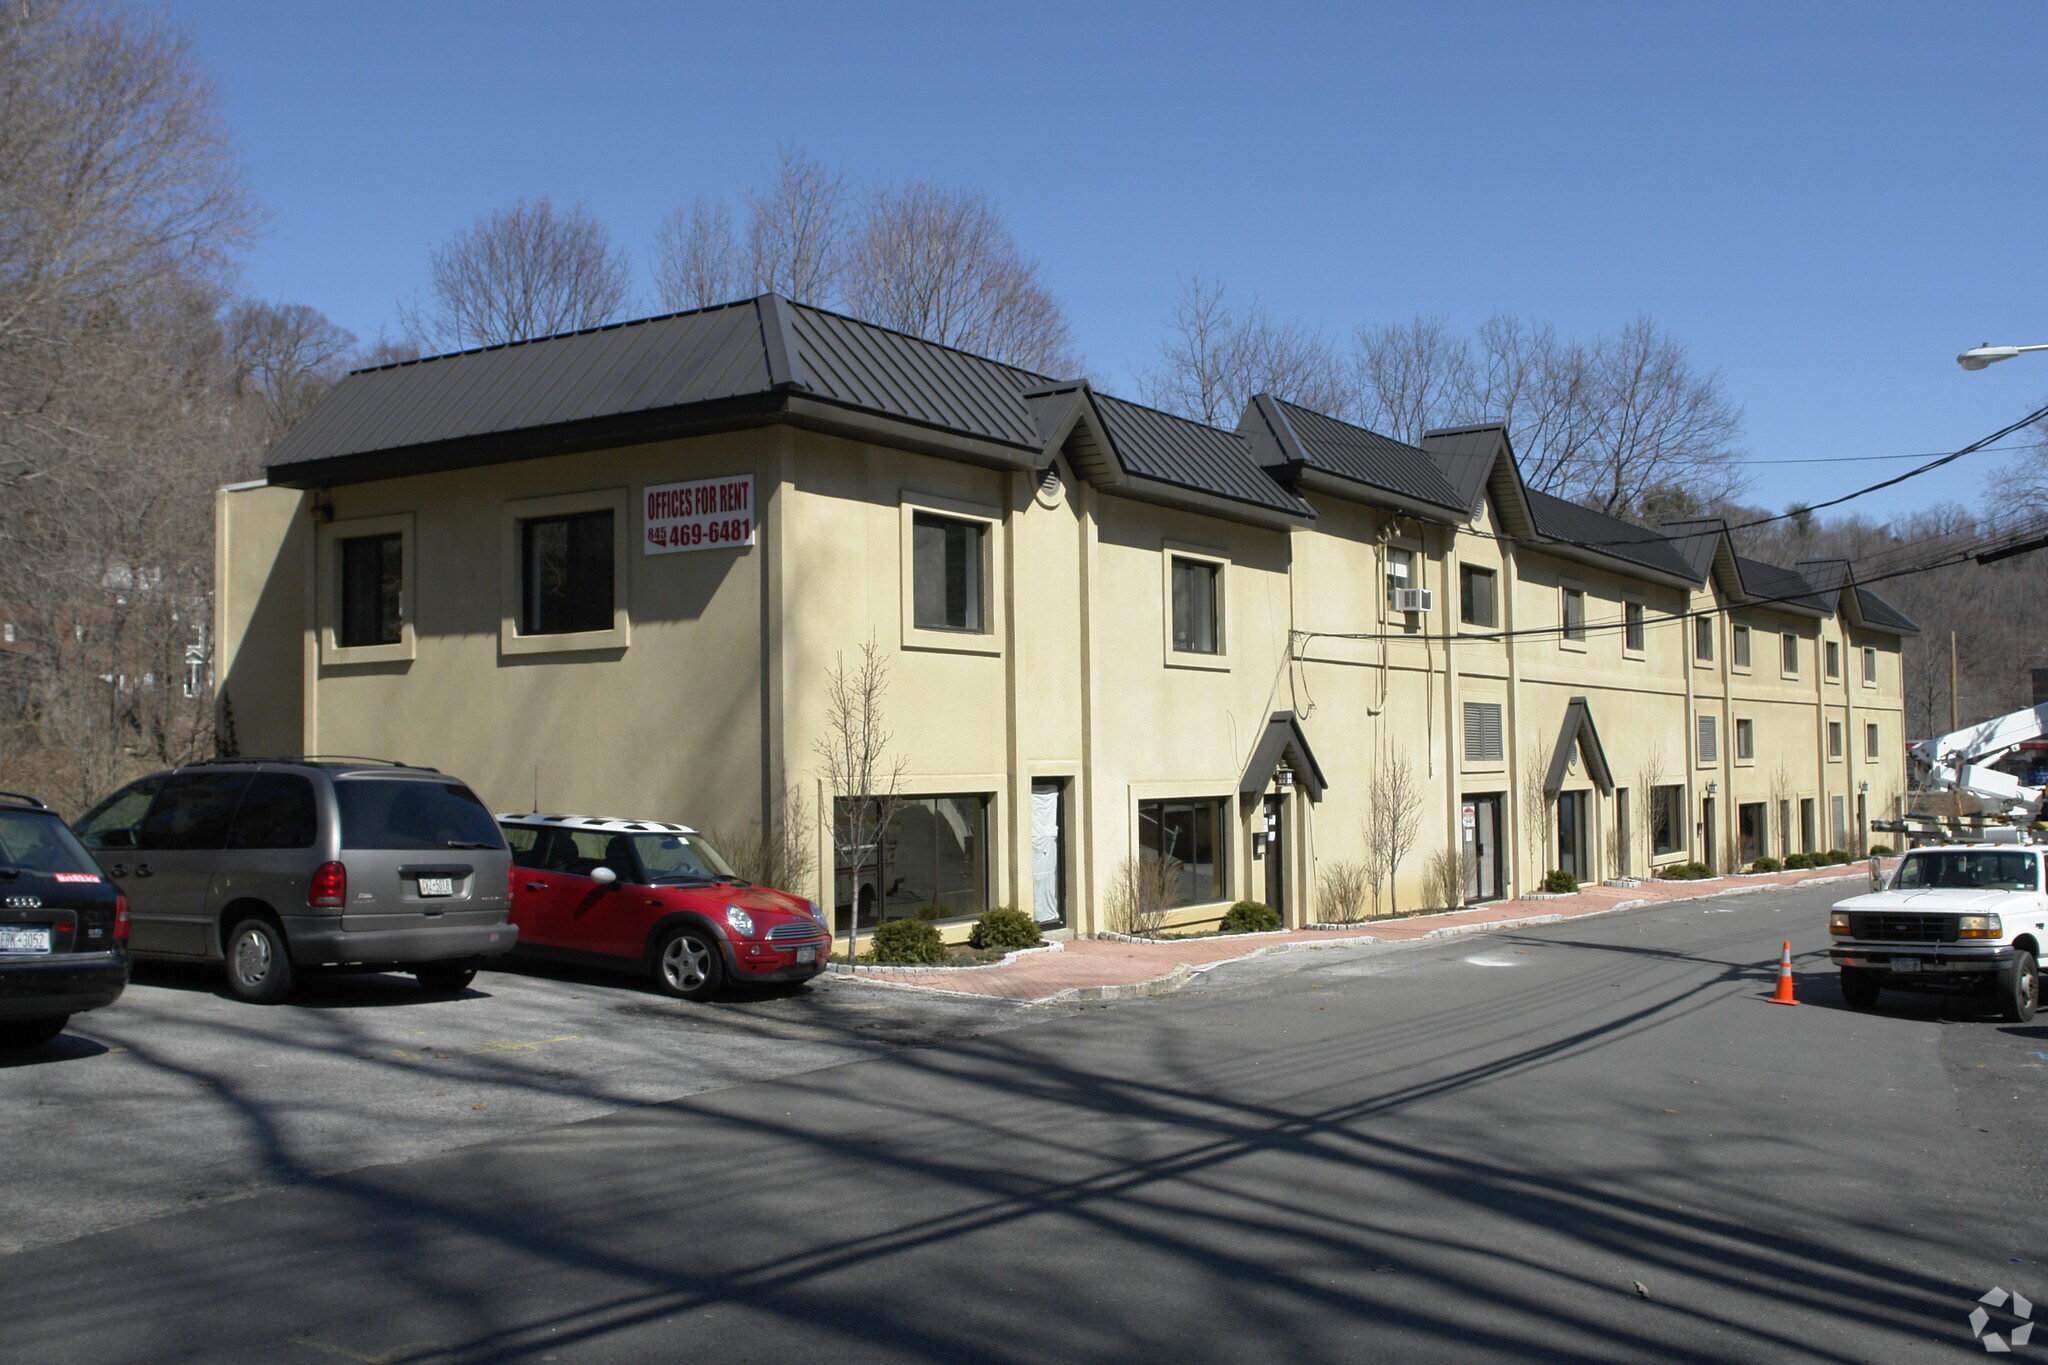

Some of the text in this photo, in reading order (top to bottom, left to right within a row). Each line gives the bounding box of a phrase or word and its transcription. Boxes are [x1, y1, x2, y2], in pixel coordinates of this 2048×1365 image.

[648, 482, 749, 520] OFFICES FOR RENT
[648, 518, 749, 546] 845 469-6481
